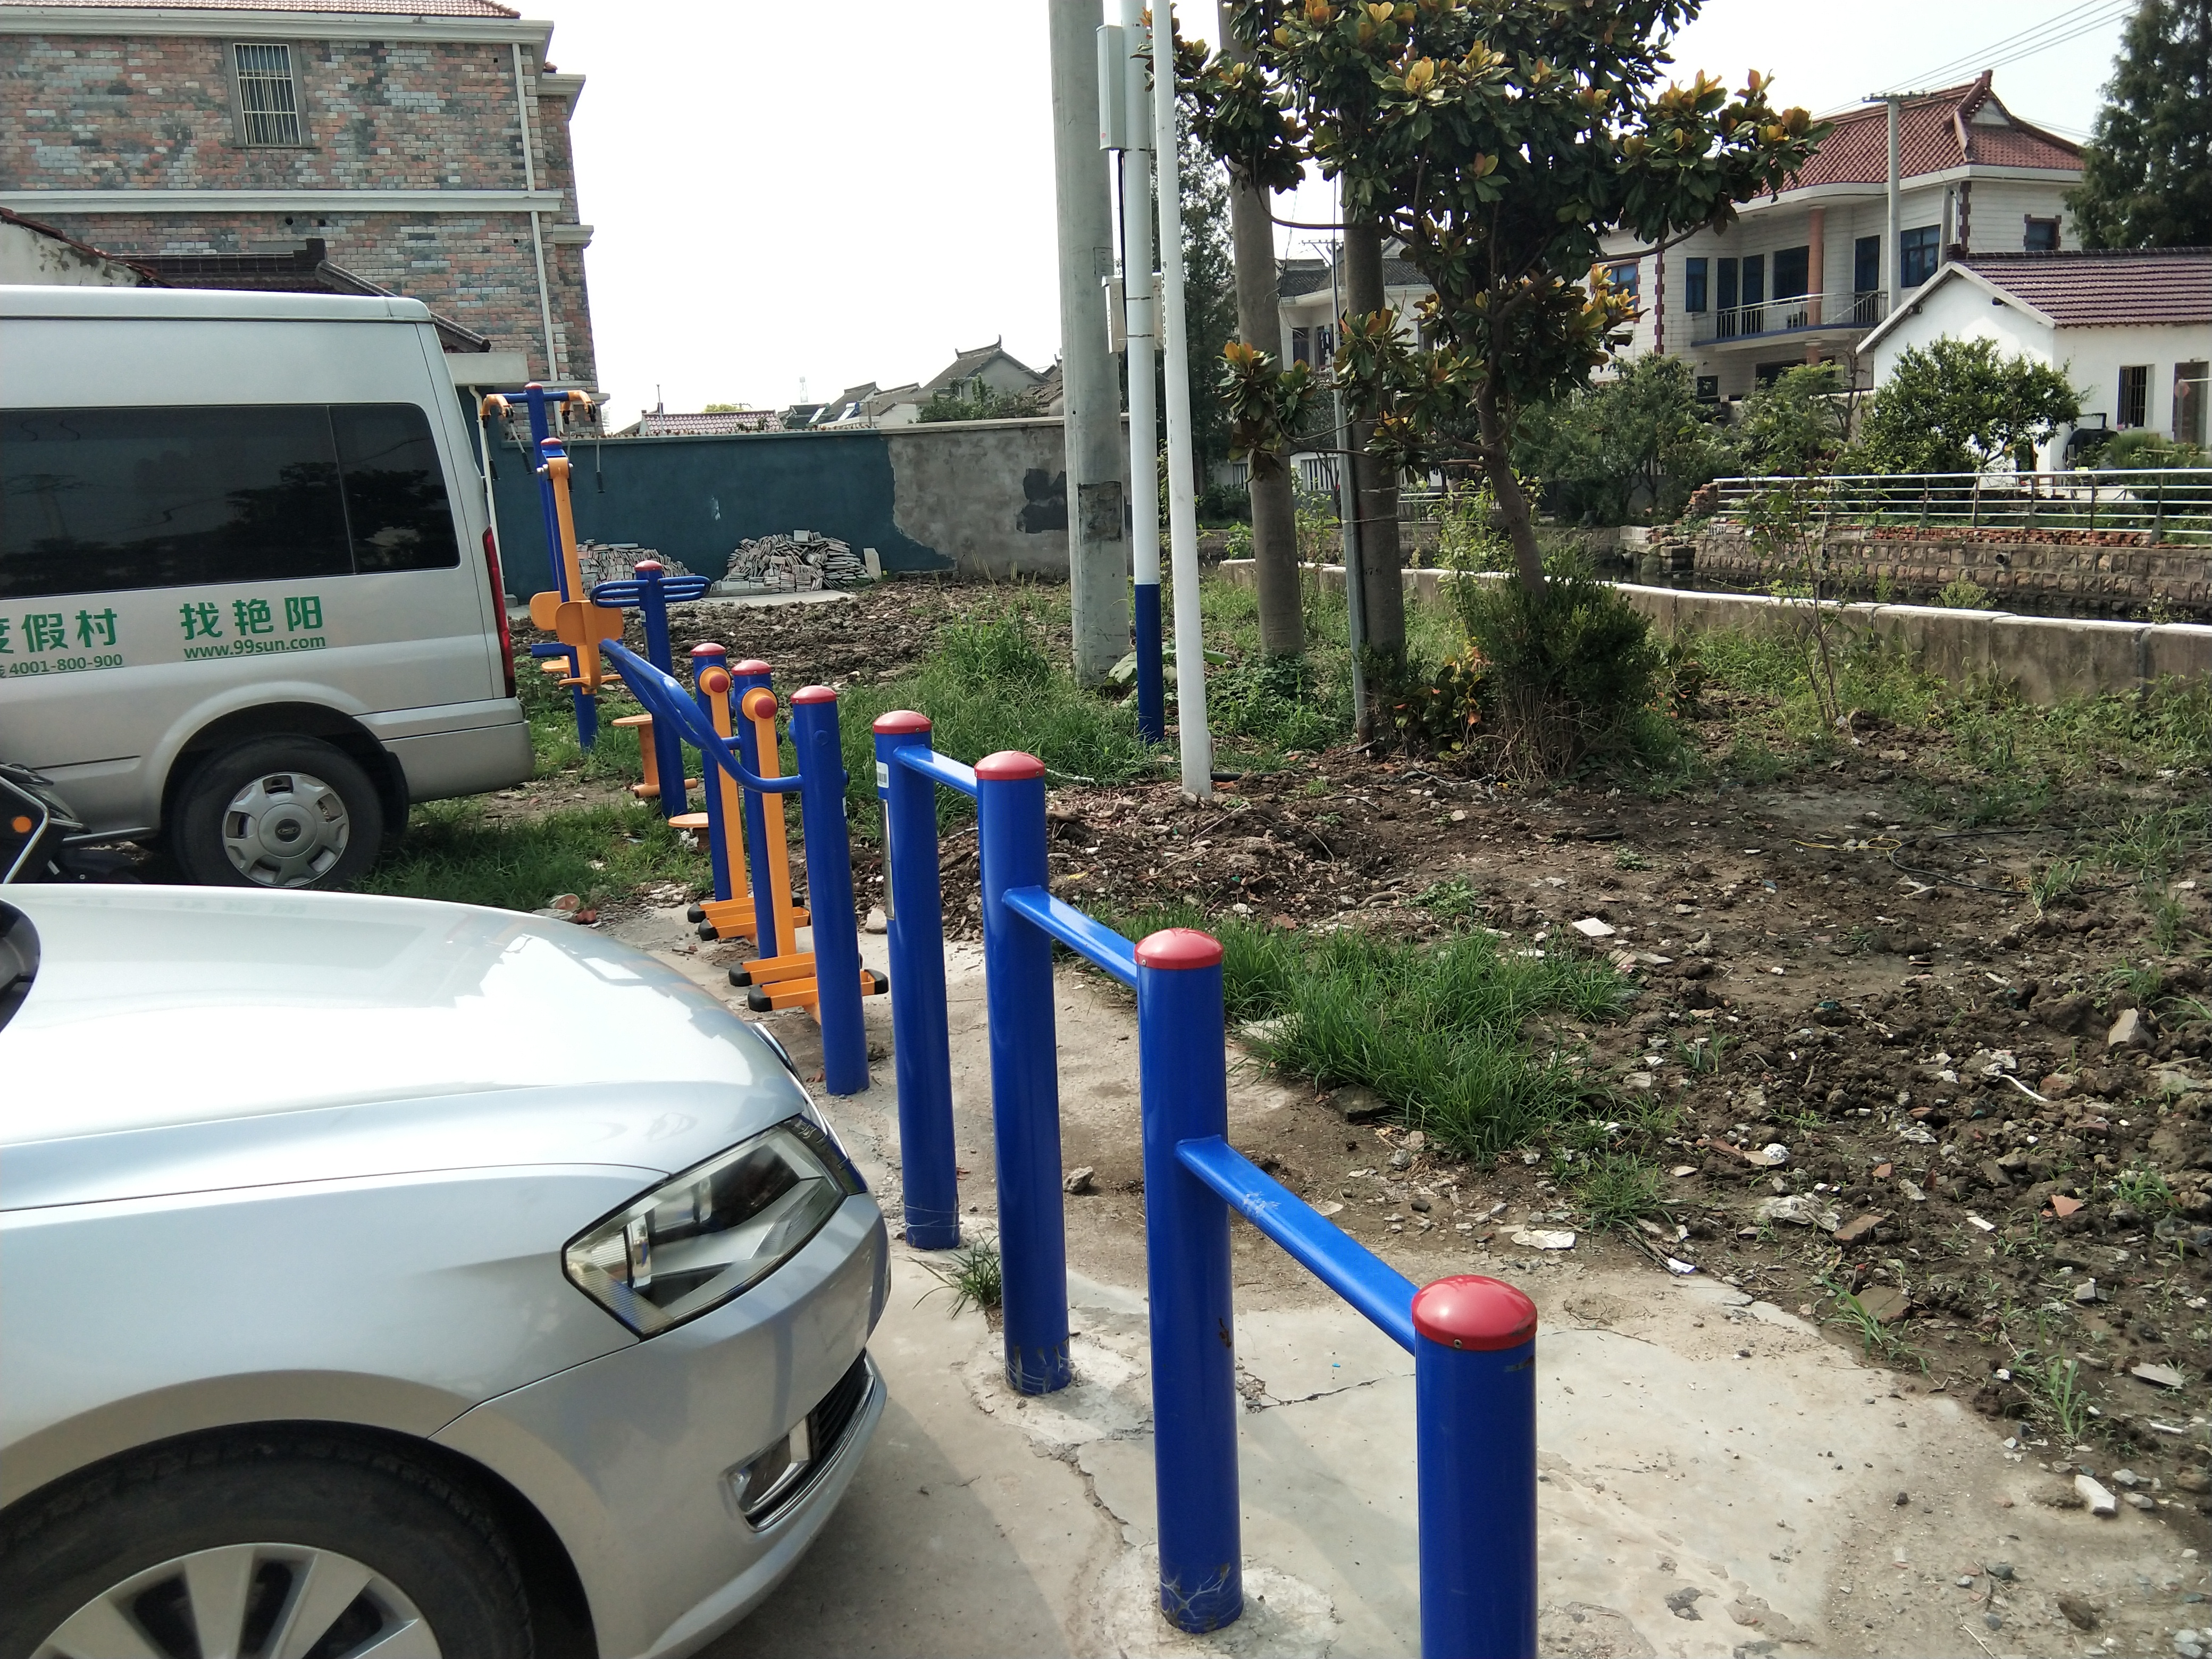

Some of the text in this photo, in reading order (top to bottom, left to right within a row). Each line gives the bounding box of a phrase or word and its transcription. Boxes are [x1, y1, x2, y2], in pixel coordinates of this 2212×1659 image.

[179, 596, 323, 640] 找艳阳
[183, 636, 326, 659] www.99sun.com
[9, 653, 123, 675] 4001-800-900
